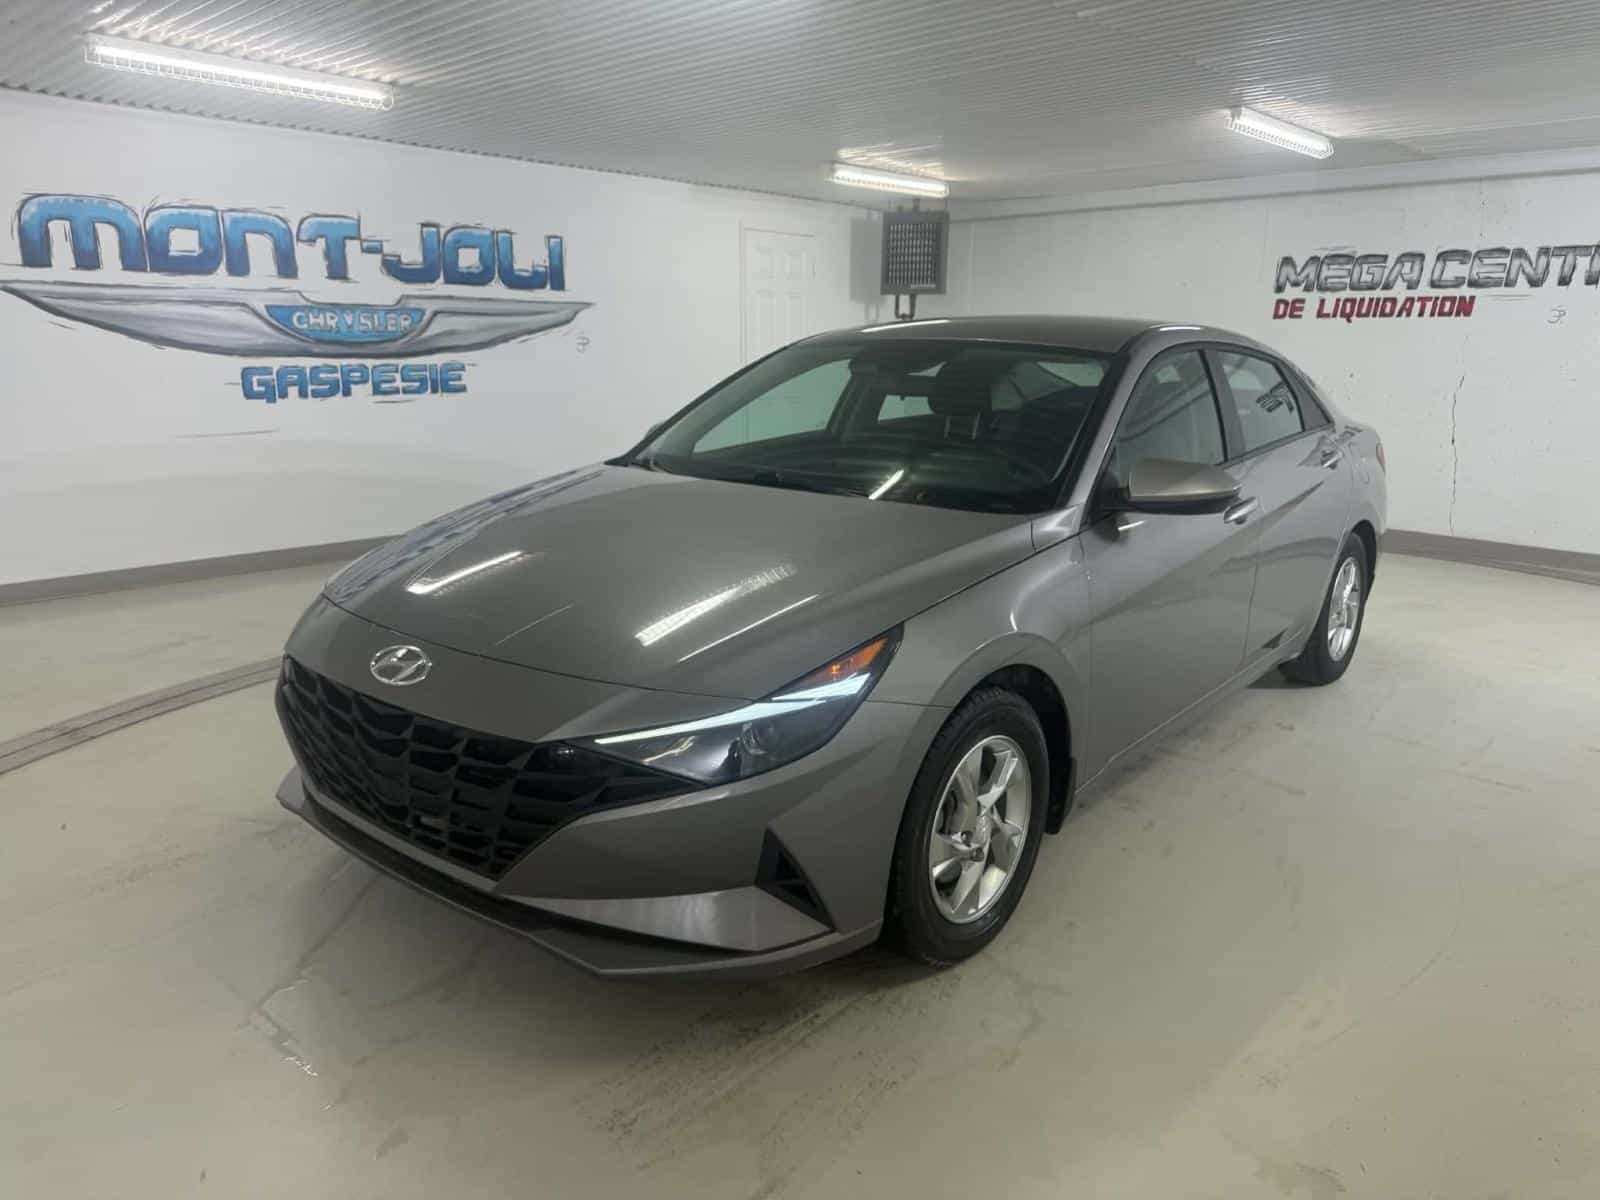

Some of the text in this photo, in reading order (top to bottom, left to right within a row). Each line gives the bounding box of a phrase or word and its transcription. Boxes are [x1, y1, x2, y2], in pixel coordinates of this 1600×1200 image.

[1274, 253, 1426, 292] MEGA
[290, 309, 415, 334] CHRYSLER
[1272, 295, 1477, 323] DE LIQUIDATION
[240, 361, 467, 403] GASPESIE
